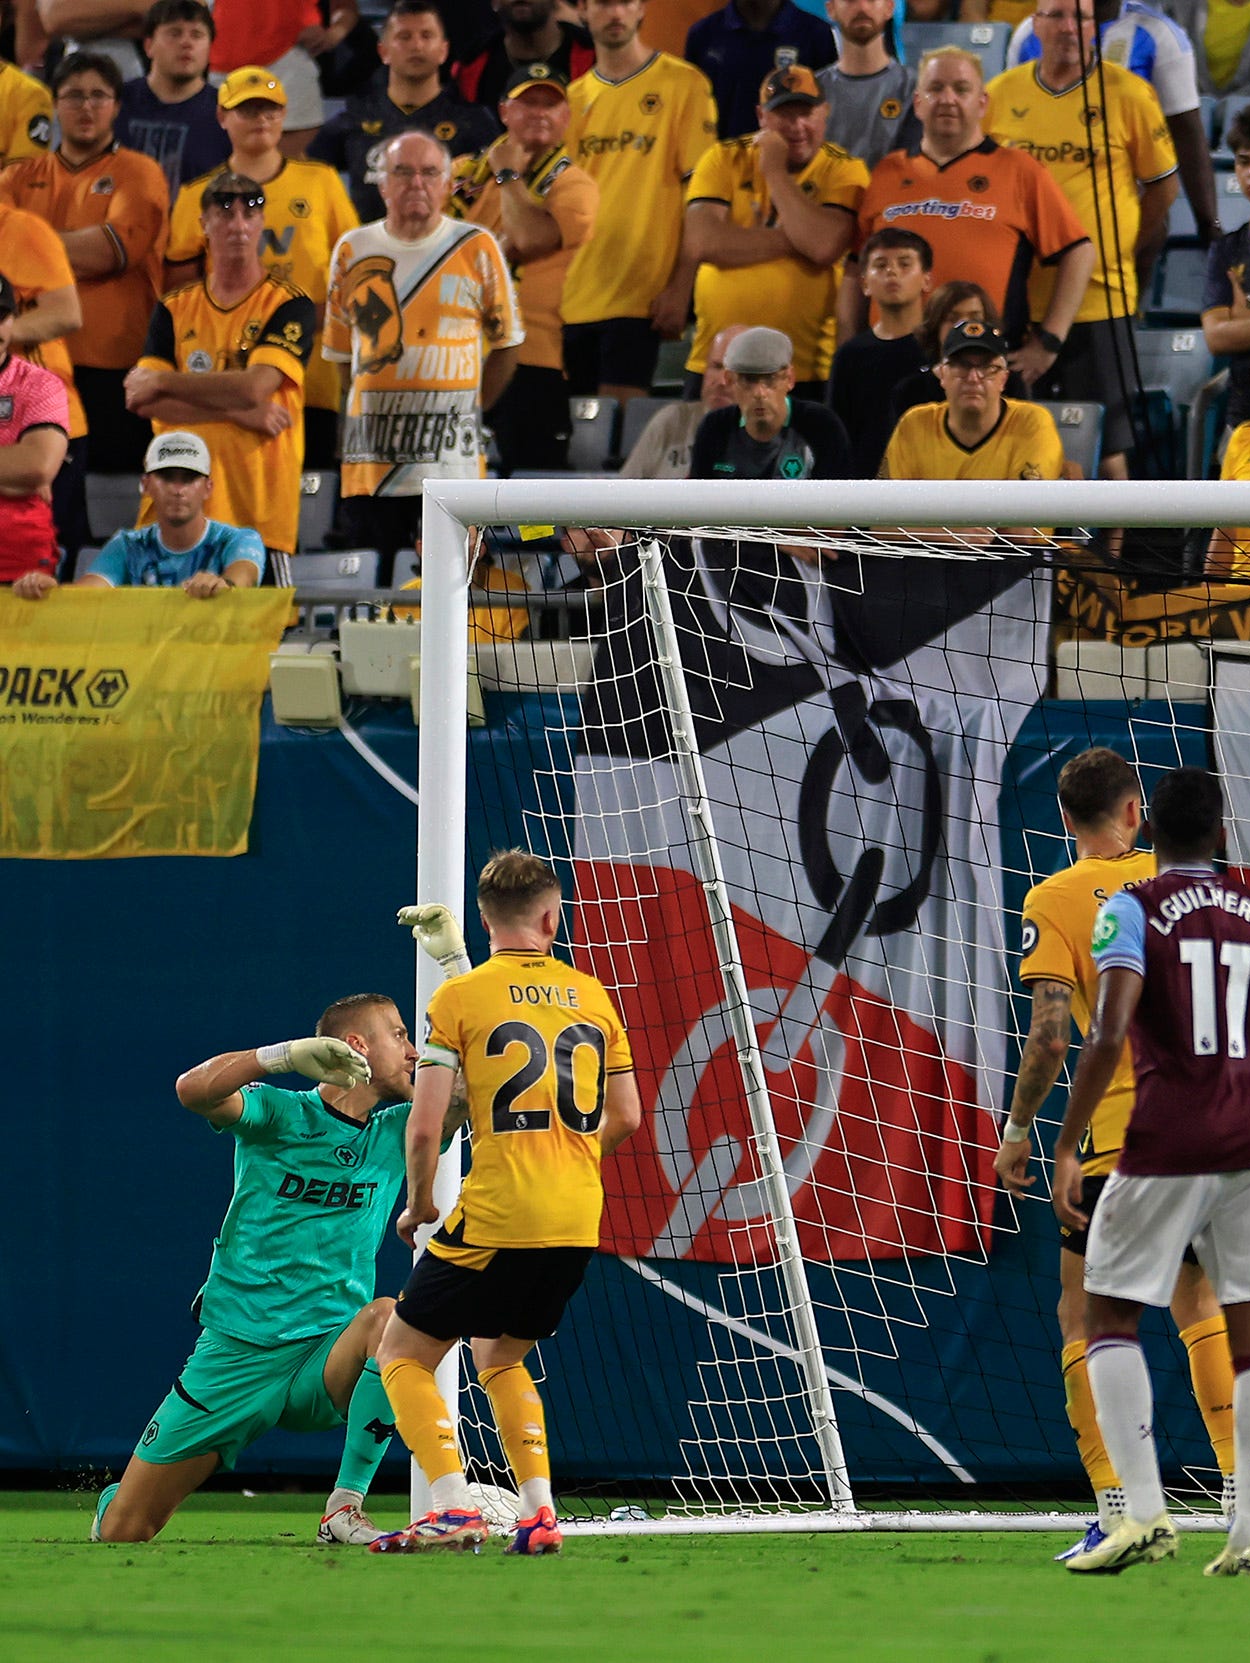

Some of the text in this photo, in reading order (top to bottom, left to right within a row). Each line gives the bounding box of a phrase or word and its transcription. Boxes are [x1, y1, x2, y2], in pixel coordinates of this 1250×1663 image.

[884, 198, 997, 222] sportingbet
[395, 343, 478, 380] WOLVES
[22, 712, 101, 726] Wanderers
[508, 984, 580, 1010] DOYLE
[484, 1020, 607, 1136] 20
[276, 1172, 379, 1209] DEBET
